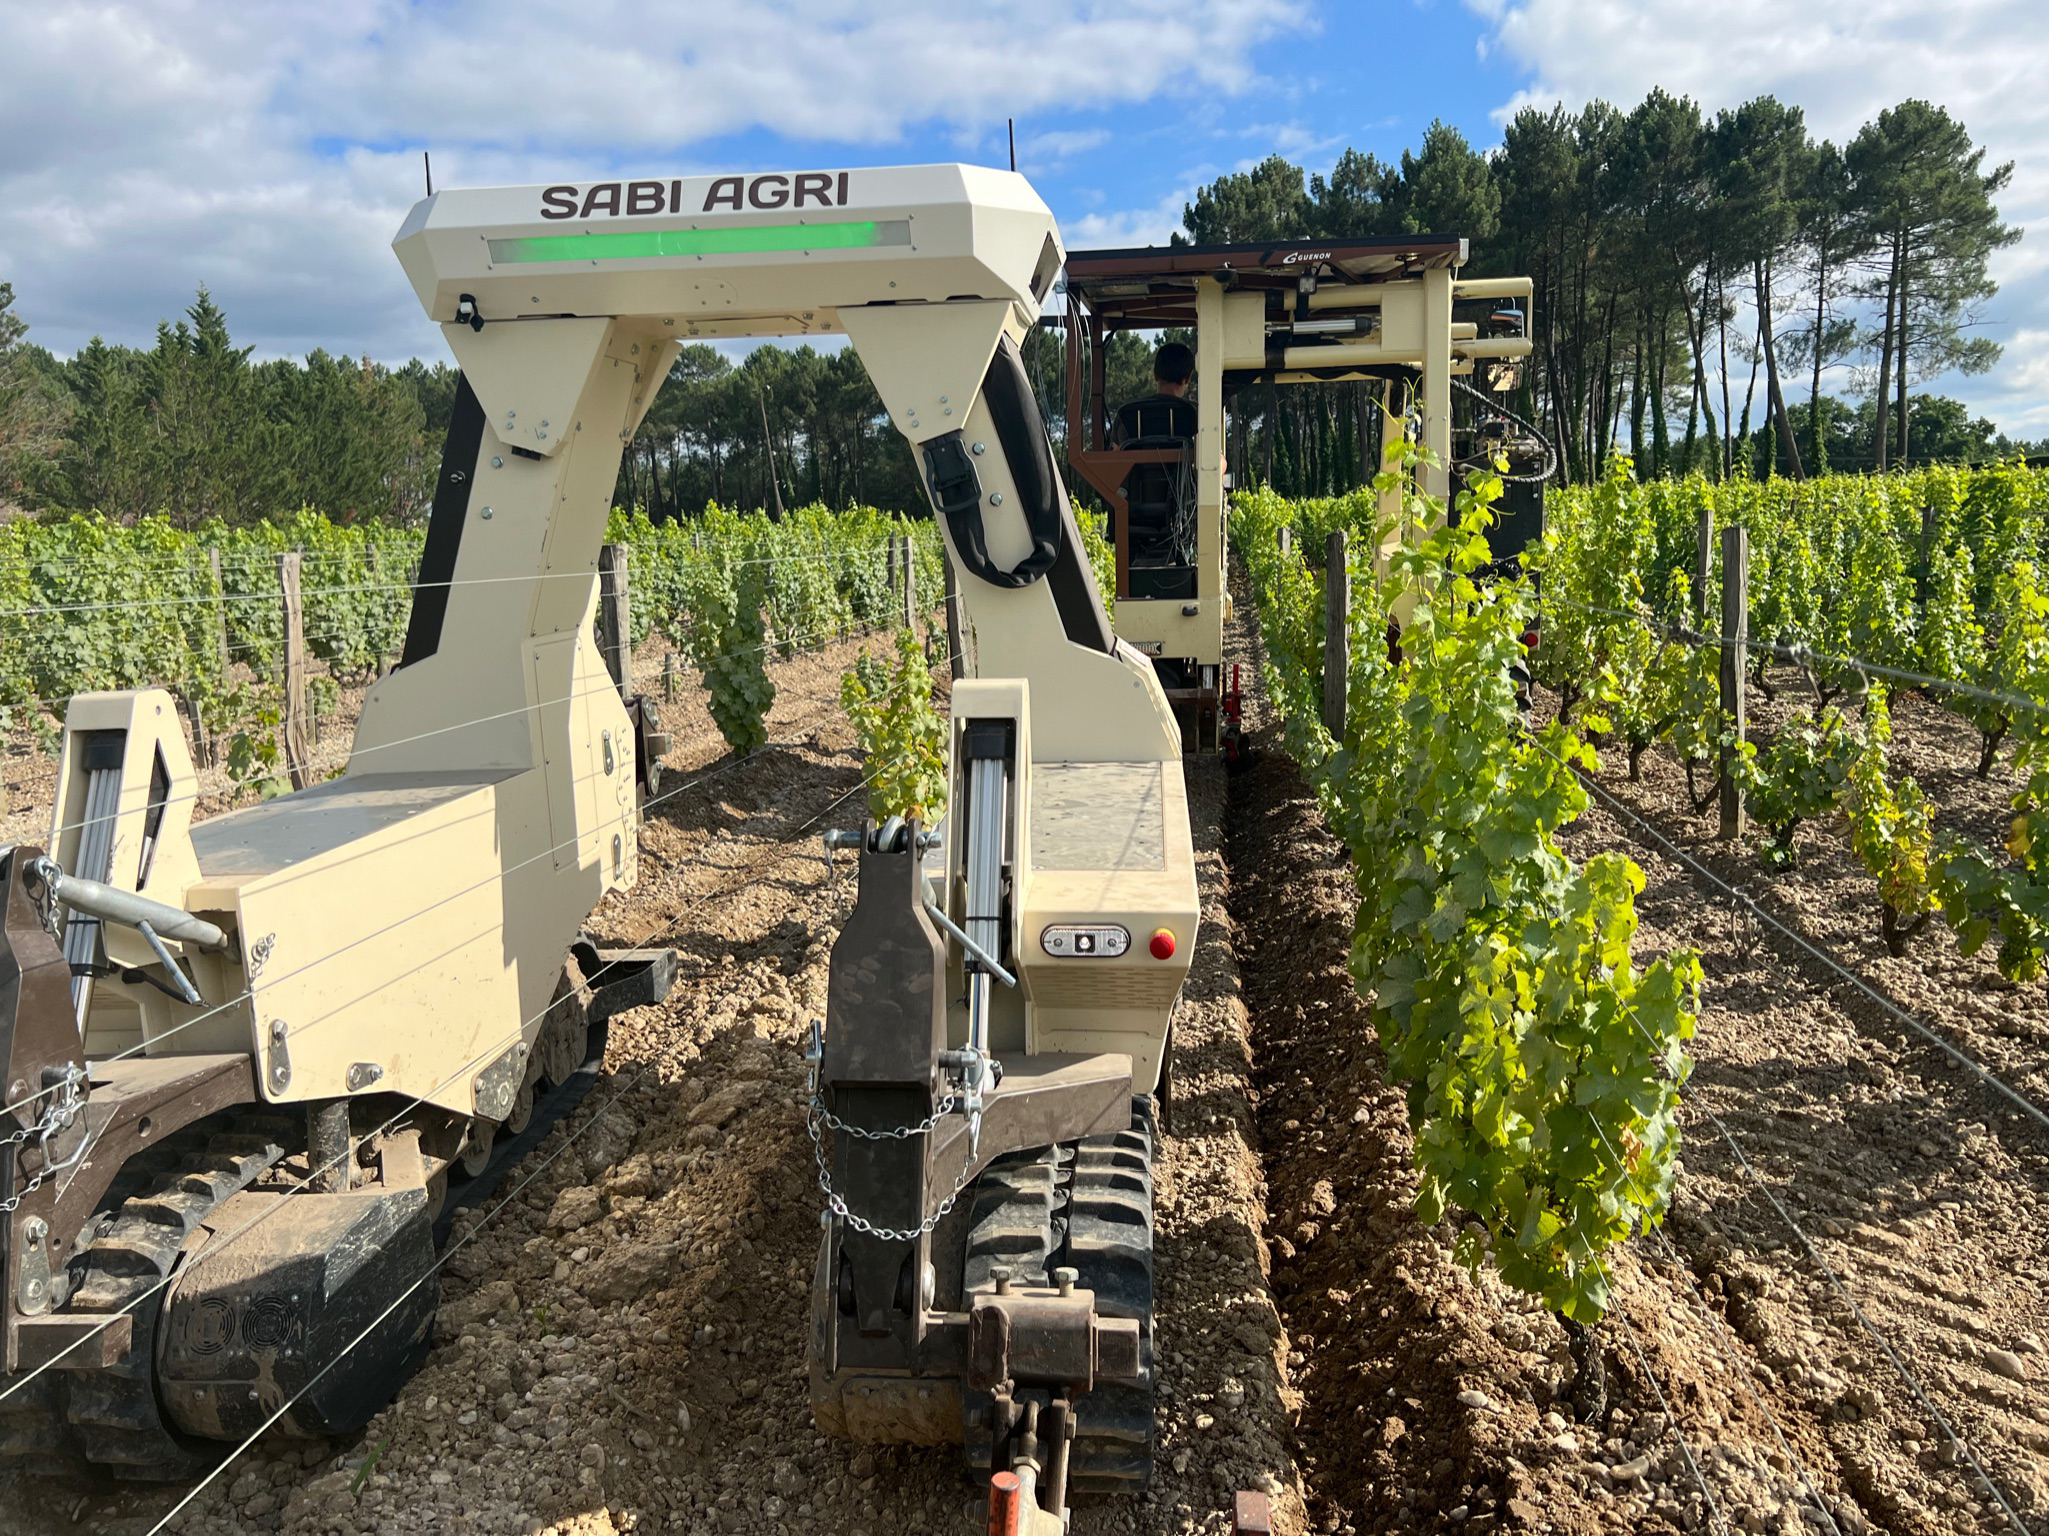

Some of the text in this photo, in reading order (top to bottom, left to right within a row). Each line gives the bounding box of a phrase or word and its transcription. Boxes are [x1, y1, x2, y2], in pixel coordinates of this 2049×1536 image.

[540, 172, 849, 220] SABI AGRI
[1297, 252, 1331, 261] GUENON
